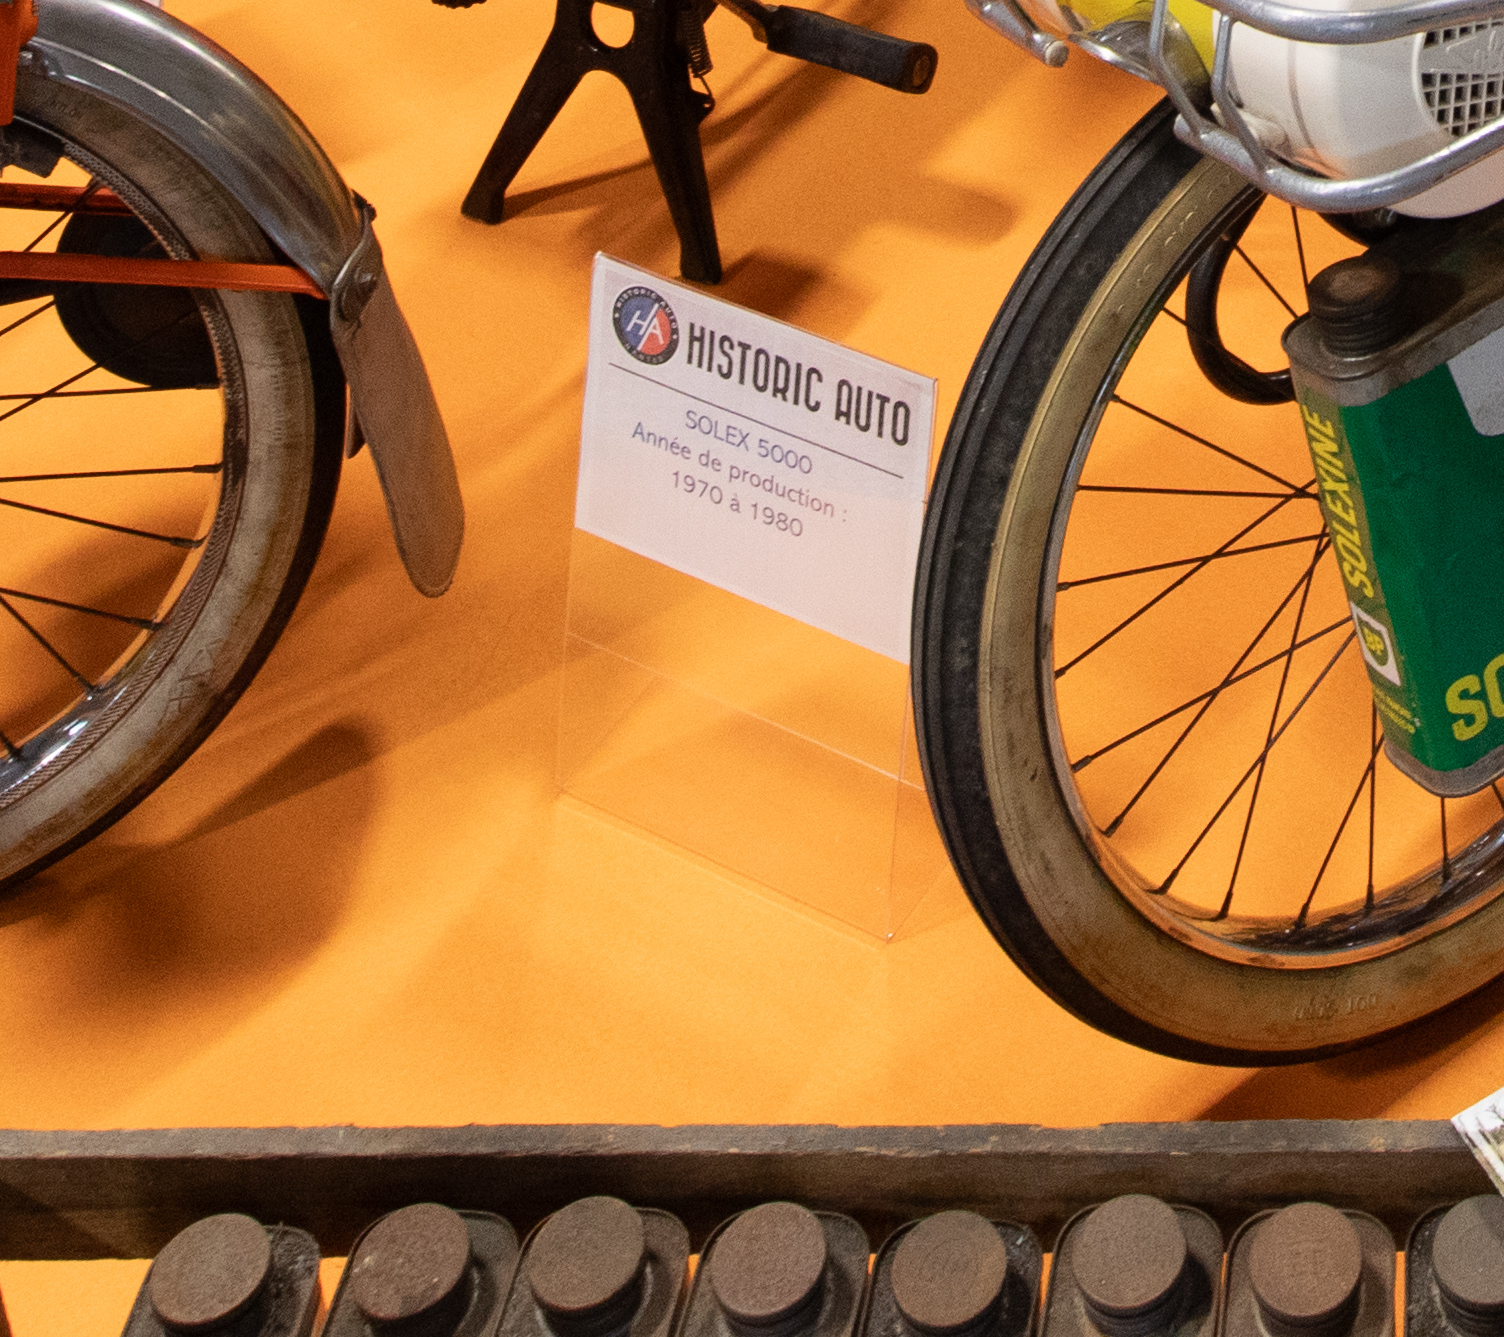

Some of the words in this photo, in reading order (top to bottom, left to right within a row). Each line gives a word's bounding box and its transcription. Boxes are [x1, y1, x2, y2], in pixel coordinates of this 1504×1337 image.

[686, 322, 823, 413] HISTORIC
[835, 379, 911, 446] AUTO
[632, 421, 692, 462] Année
[698, 448, 723, 473] de
[729, 460, 836, 519] production
[685, 410, 750, 452] SOLEX
[757, 439, 813, 475] 5000
[672, 471, 723, 505] 1970
[729, 493, 742, 515] à
[750, 502, 804, 538] 1980
[1305, 405, 1375, 598] SOLEXINE
